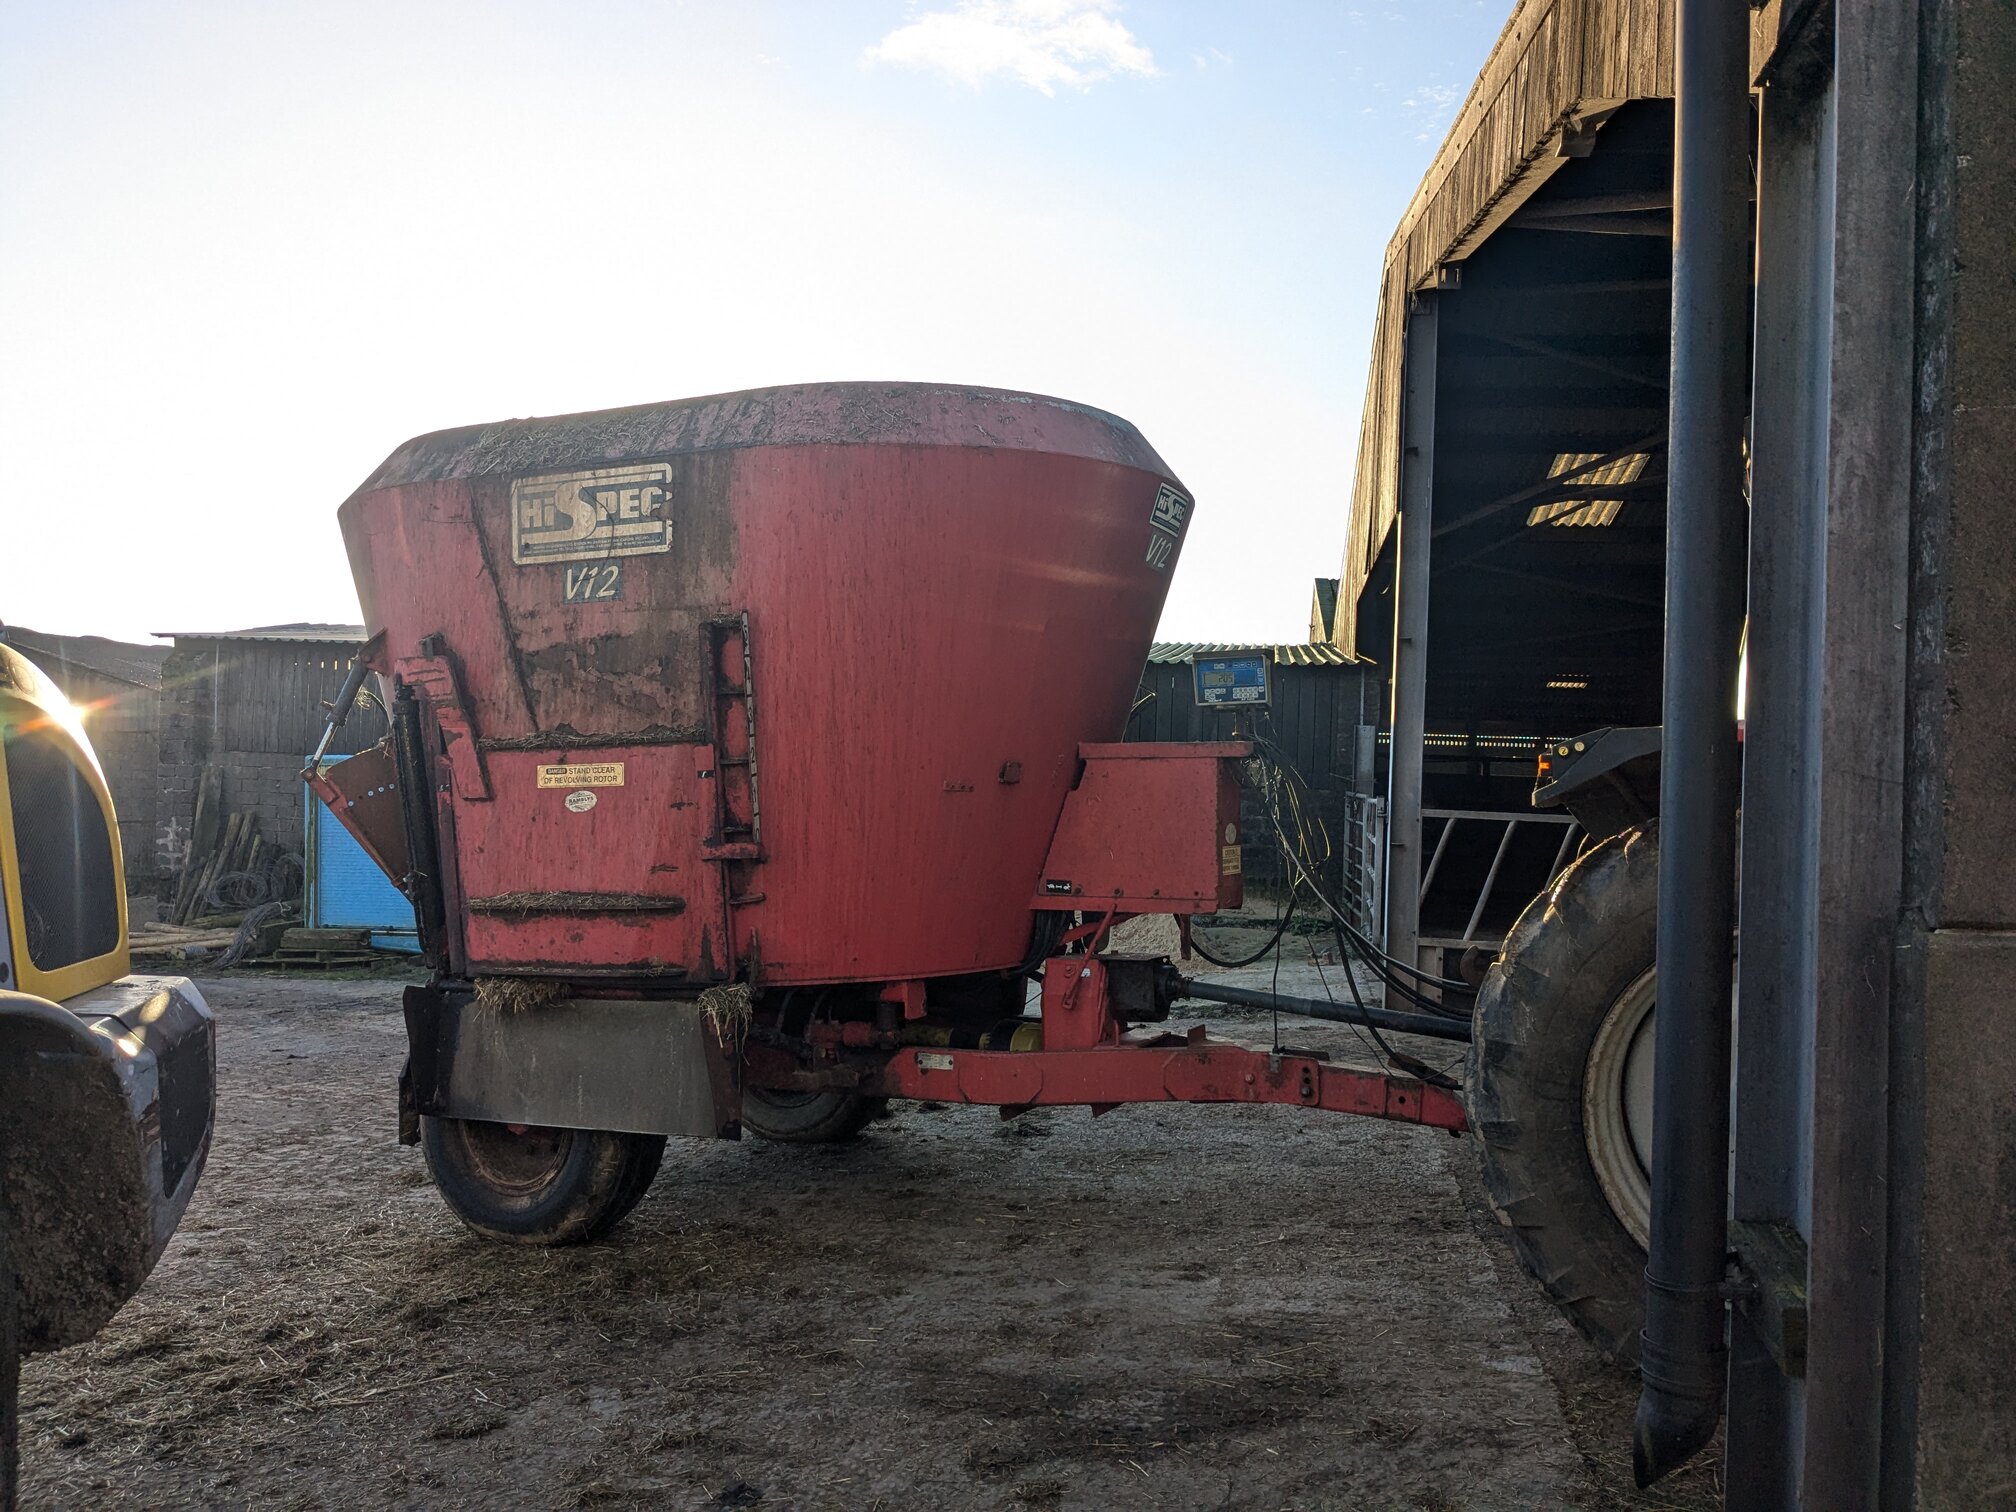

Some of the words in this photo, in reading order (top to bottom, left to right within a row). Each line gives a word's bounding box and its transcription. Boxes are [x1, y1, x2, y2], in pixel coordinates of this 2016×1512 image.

[1145, 534, 1172, 569] V12
[566, 565, 619, 600] V12
[554, 776, 592, 784] REVOLVING
[568, 767, 591, 775] STAND
[592, 766, 615, 774] CLEAR
